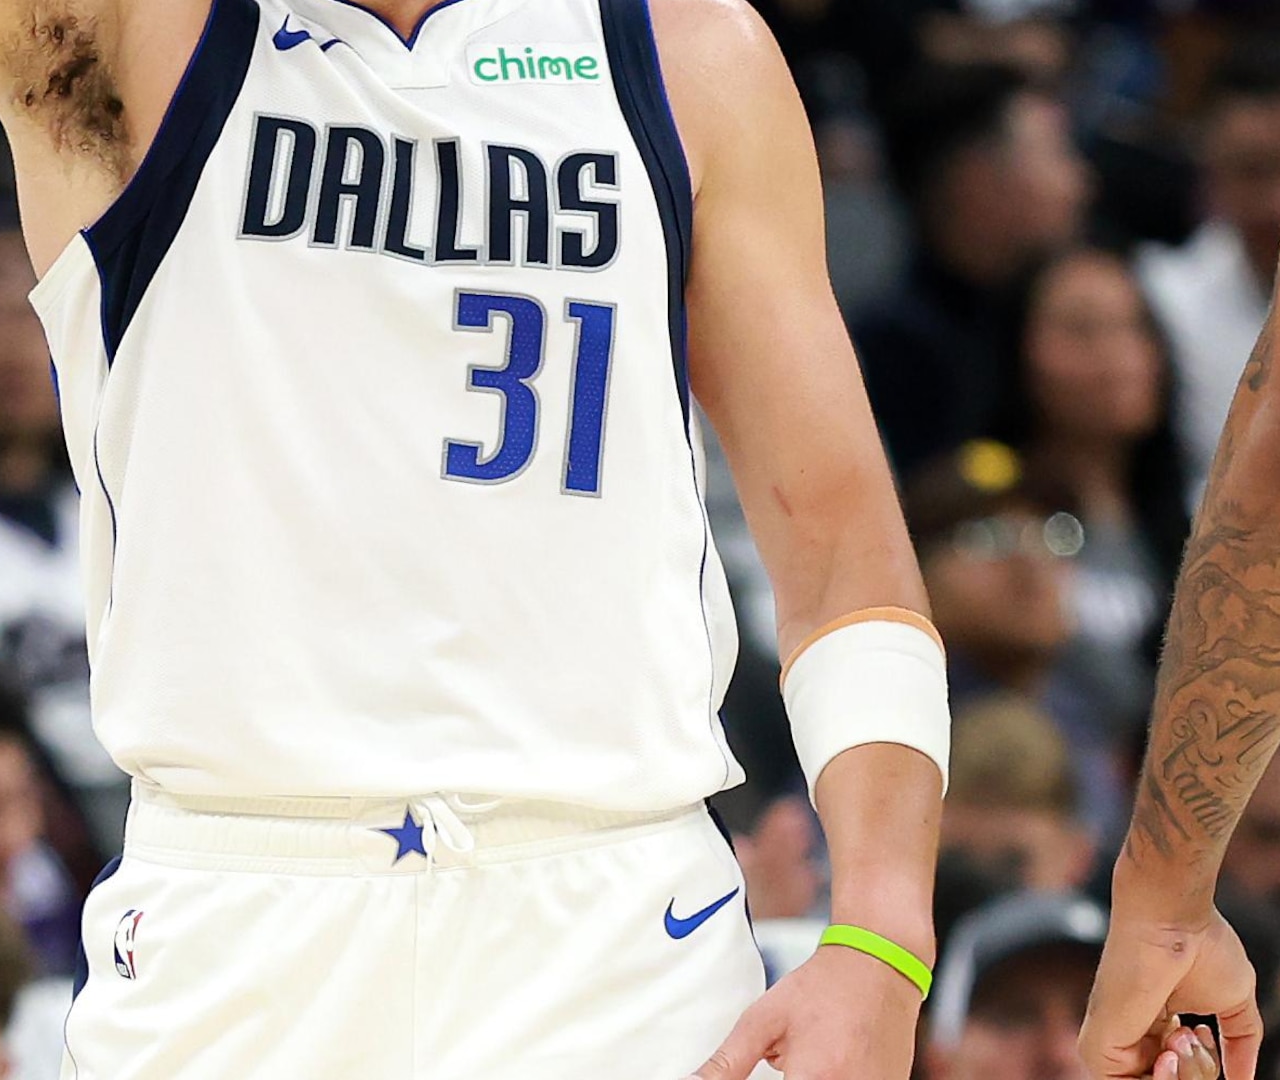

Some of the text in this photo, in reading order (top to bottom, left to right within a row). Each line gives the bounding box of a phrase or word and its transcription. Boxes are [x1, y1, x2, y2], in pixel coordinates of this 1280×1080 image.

[473, 47, 599, 82] chime
[236, 111, 621, 272] DALLAS
[440, 287, 618, 498] 31
